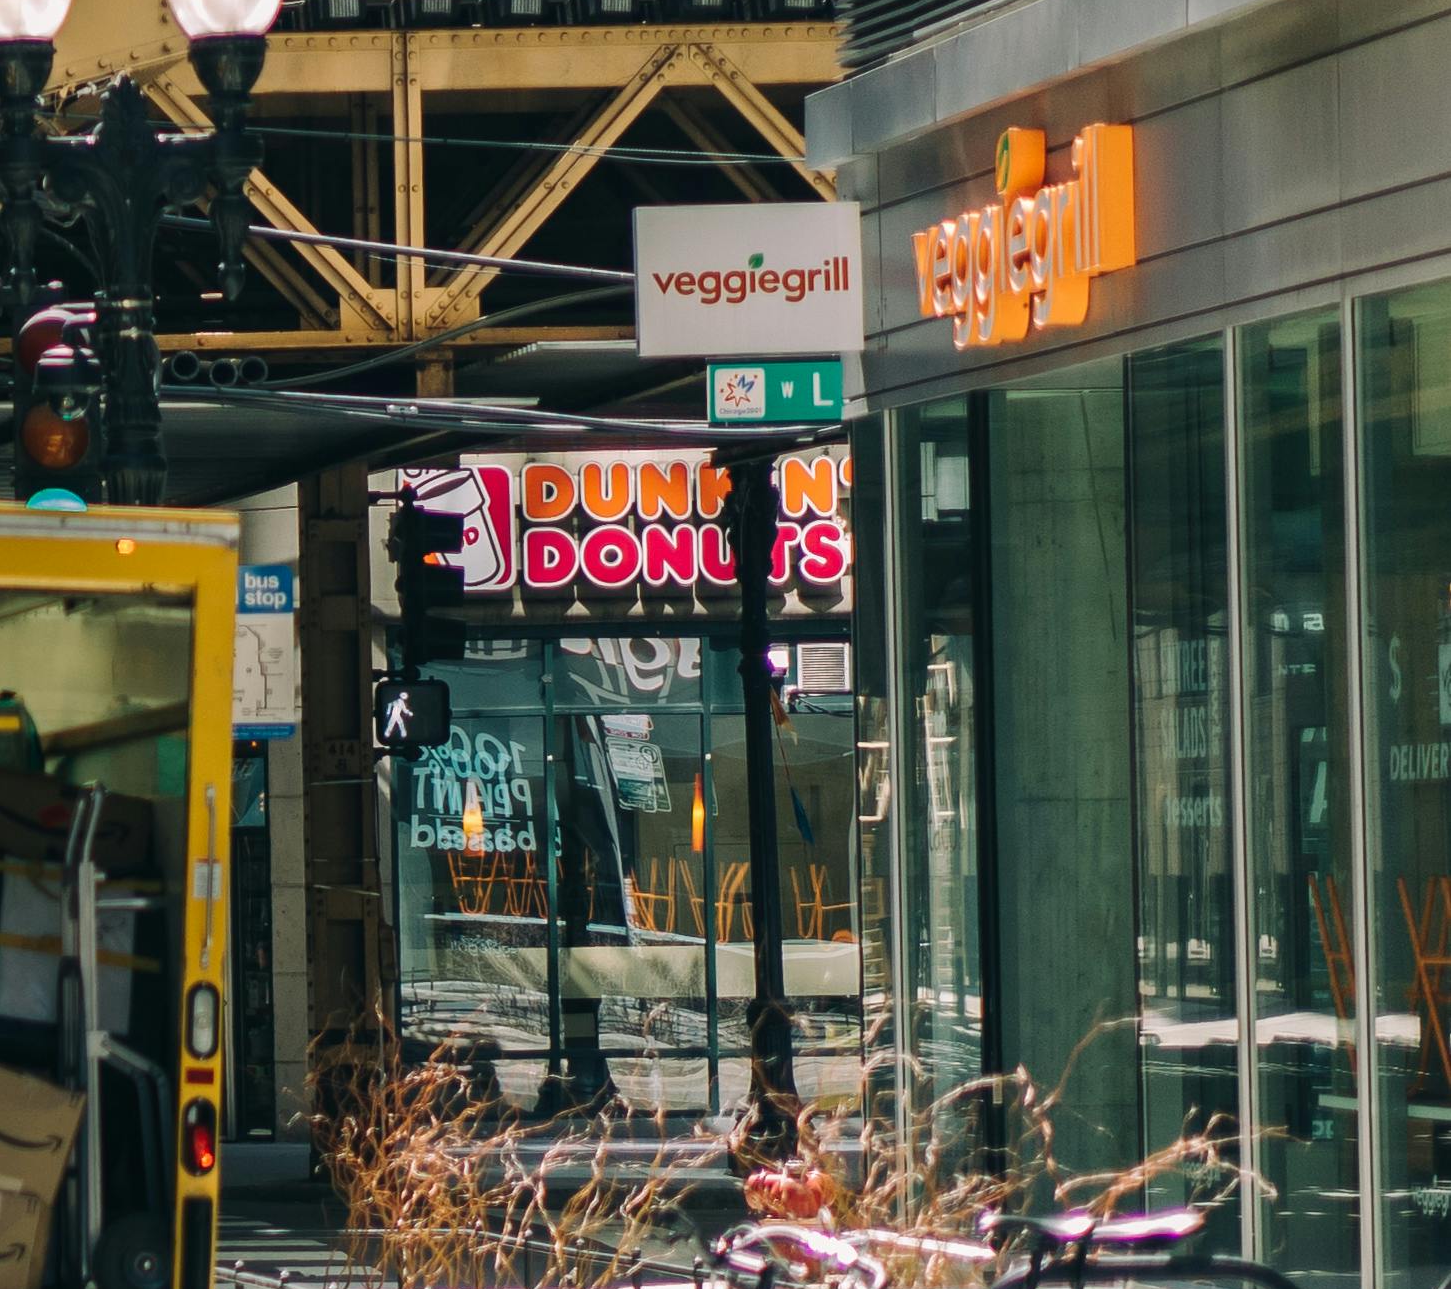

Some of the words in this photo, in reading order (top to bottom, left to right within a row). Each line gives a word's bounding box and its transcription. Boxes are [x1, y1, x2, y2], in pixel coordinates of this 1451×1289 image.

[911, 123, 1134, 350] veggiegrill
[652, 256, 849, 305] veggiegrill
[781, 381, 794, 399] W
[520, 457, 852, 522] DUNKN'
[522, 521, 848, 587] DONUTS
[244, 573, 279, 589] bus
[244, 591, 287, 609] stop
[1390, 742, 1451, 781] DELIVER
